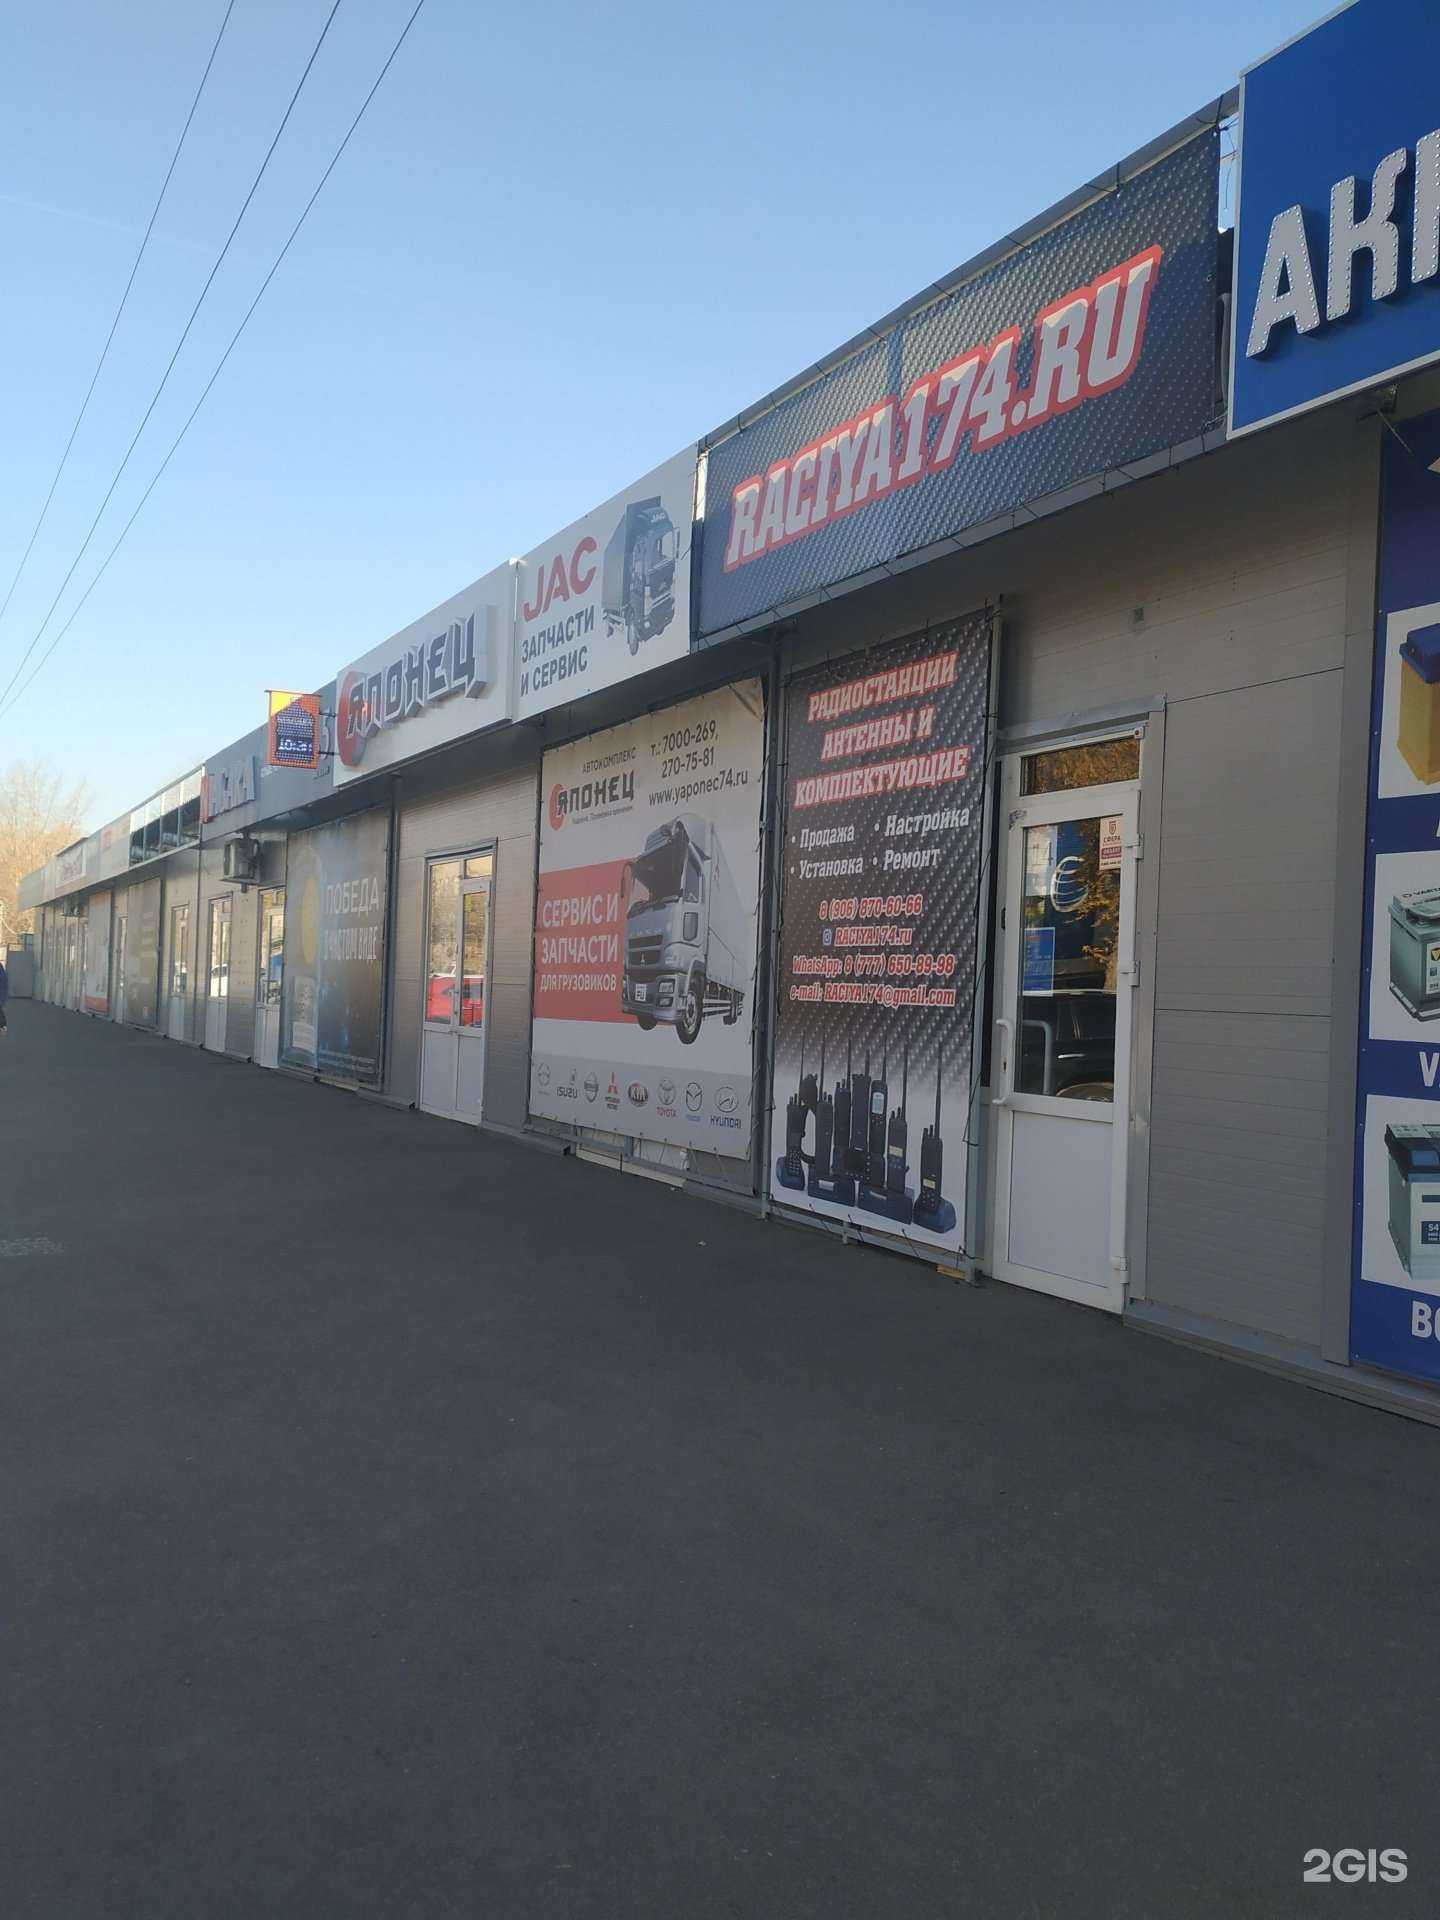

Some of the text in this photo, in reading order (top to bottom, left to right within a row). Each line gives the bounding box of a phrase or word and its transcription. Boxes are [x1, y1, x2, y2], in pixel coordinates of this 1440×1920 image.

[725, 246, 1160, 571] RACIYA174.RU
[523, 536, 598, 623] JAC
[521, 605, 595, 664] ЗАПЧАСТИ
[345, 612, 485, 738] ЯПОНЕЦ
[520, 645, 588, 697] И СЕРВИС
[808, 653, 958, 721] РАДИОСТАНЦИИ
[662, 720, 719, 754] 7000-269,
[821, 705, 935, 761] АНТЕННЫ И
[582, 746, 637, 774] АВТОКОМПЛЕКС
[661, 747, 714, 778] 270-75-81
[556, 770, 634, 816] ЯПОНЕЦ
[649, 768, 748, 806] www.yaponec74.ru
[795, 747, 971, 808] КОМПЛЕКТУЮЩИЕ
[800, 825, 855, 851] Продажа
[884, 808, 970, 837] Настройка
[799, 857, 863, 880] Установка
[883, 849, 940, 871] Ремонт
[325, 877, 379, 917] ПОБЕДА
[542, 893, 619, 928] СЕРВИС И
[819, 894, 923, 920] 8 (906) 870-60-66
[542, 934, 619, 964] ЗАПЧАСТИ
[835, 926, 912, 946] RACIYA174.ru
[793, 953, 956, 977] WhatsApp: 8 (777) 650-89-98
[540, 974, 616, 993] ДЛЯ ГРУЗОВИКОВ
[790, 982, 957, 1009] e-mail: RACIYA174@gmail.com
[1419, 1051, 1440, 1088] V
[557, 1087, 578, 1098] ISUZU
[710, 1115, 742, 1129] HYUNDAI
[1412, 1300, 1440, 1341] B
